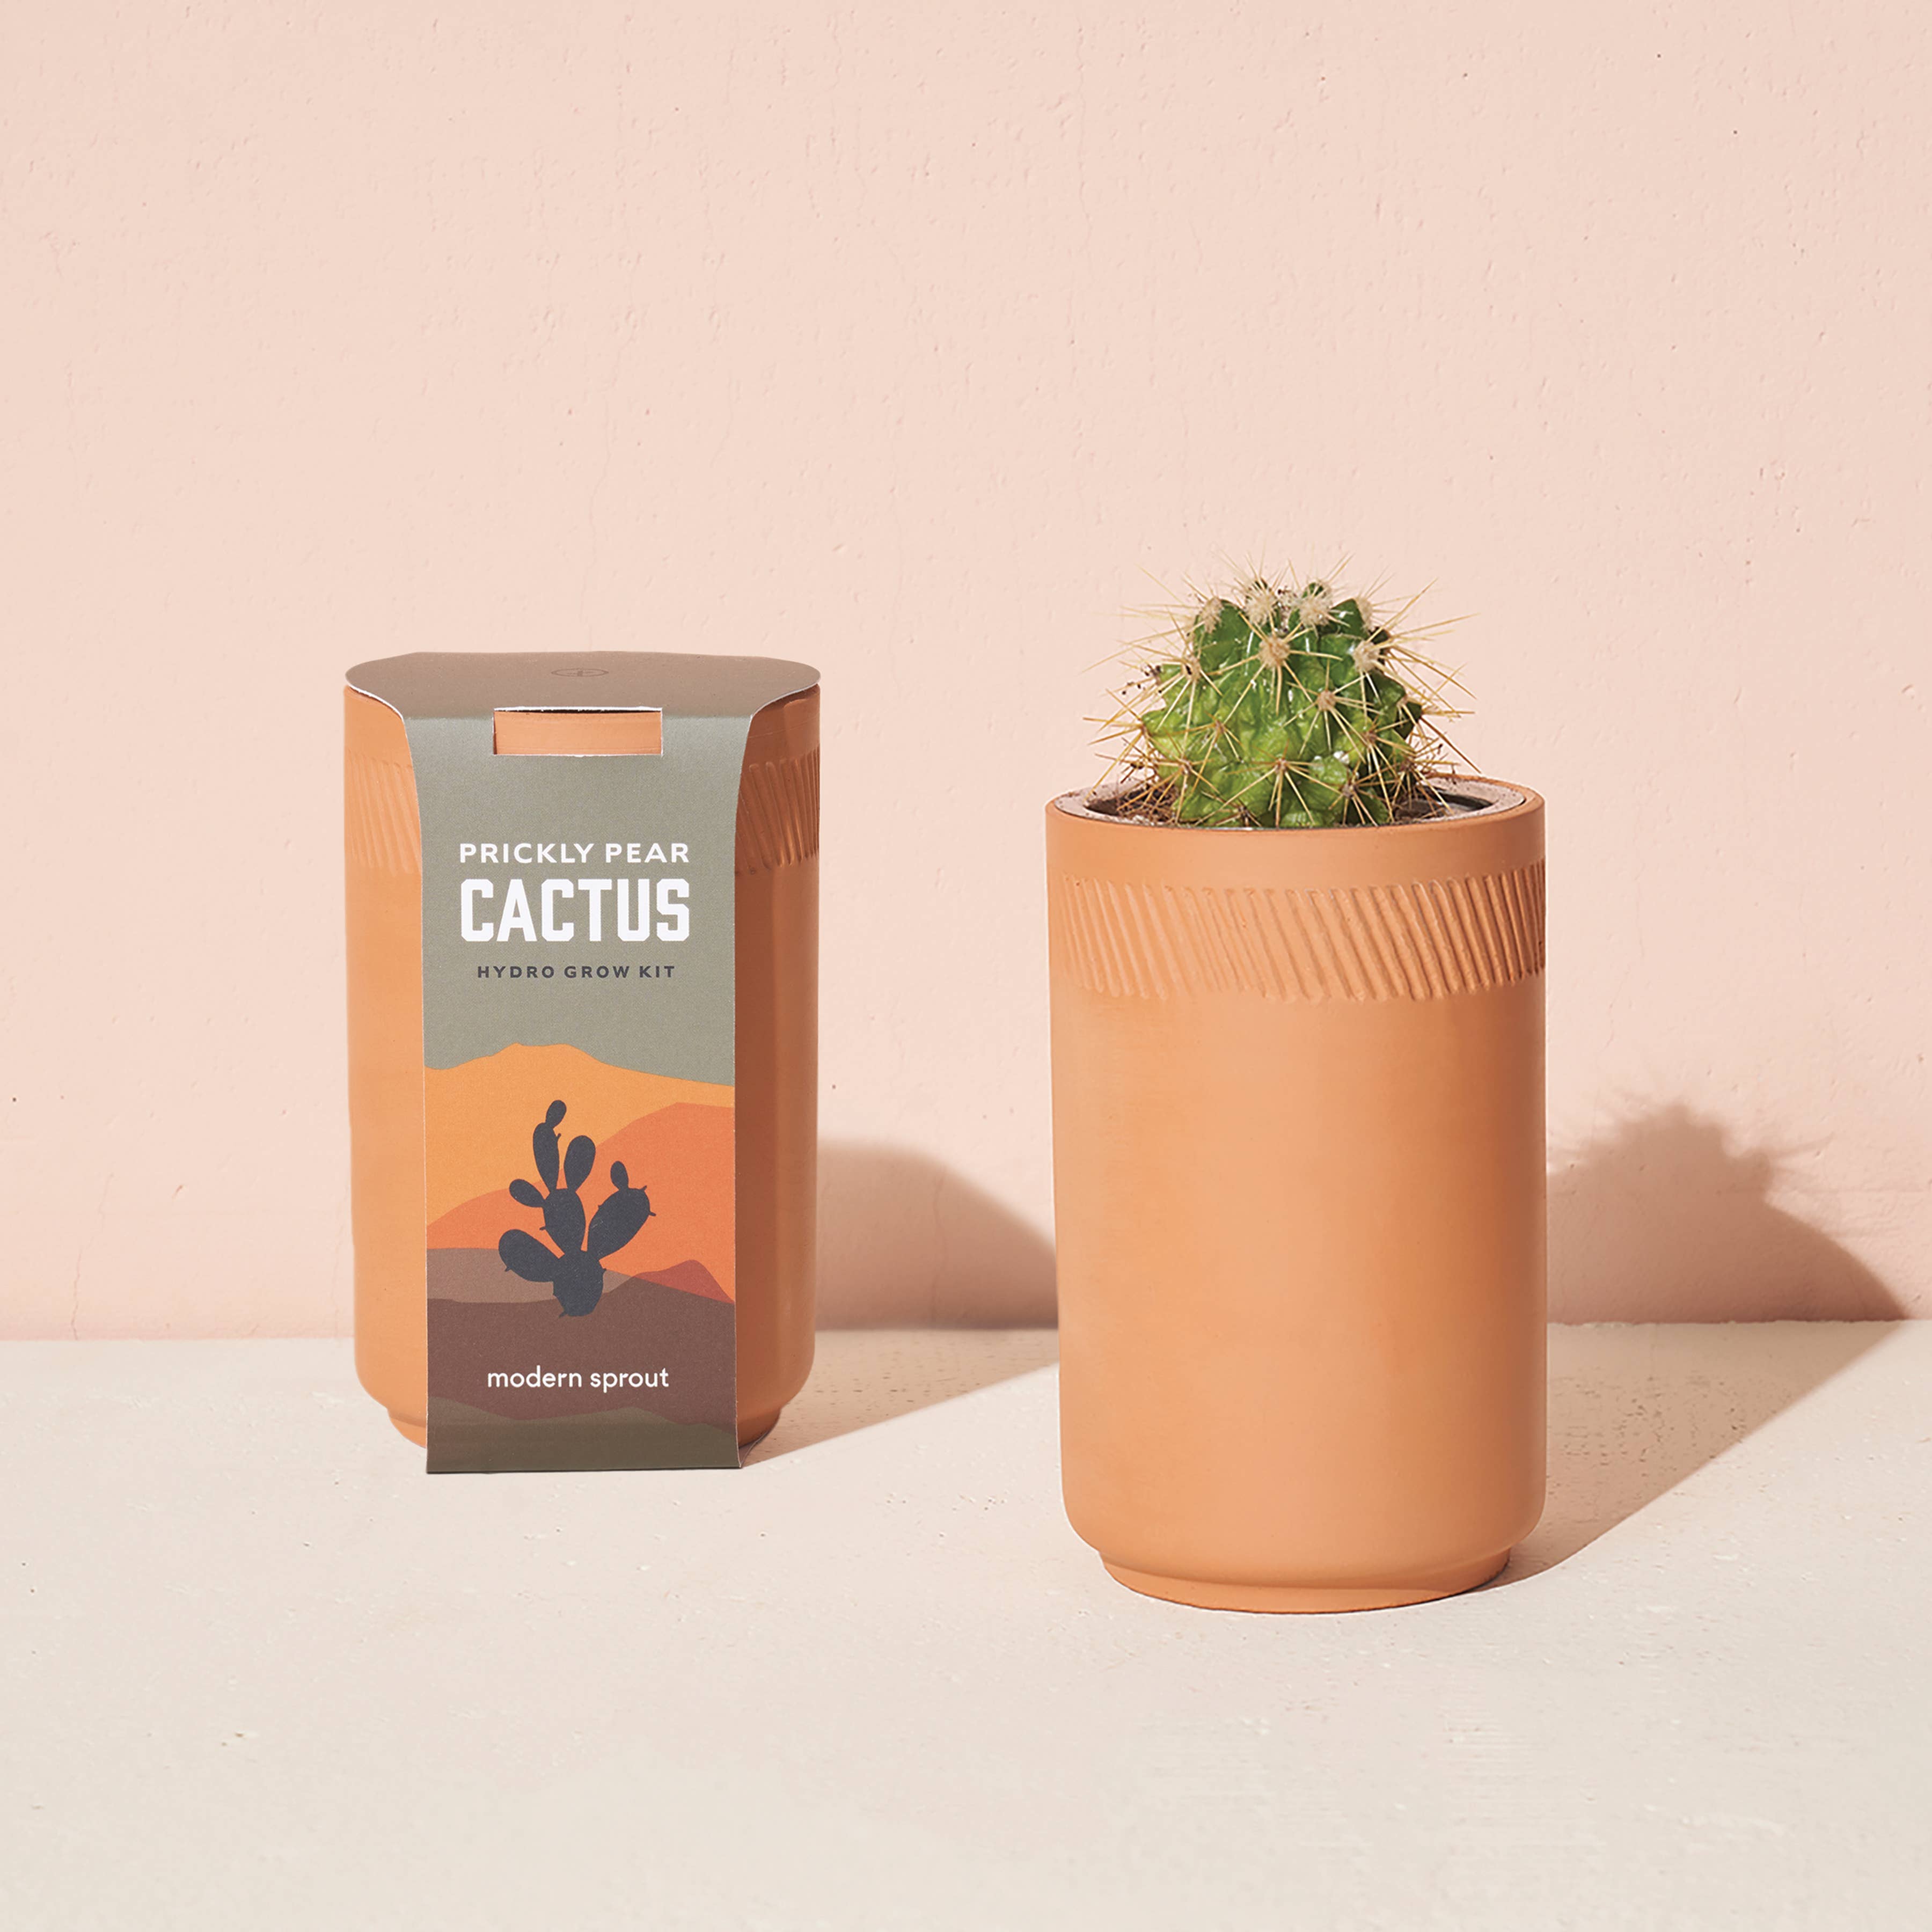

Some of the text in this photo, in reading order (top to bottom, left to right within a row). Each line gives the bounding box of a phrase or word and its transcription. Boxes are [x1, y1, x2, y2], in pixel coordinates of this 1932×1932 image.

[460, 843, 690, 863] PRICKLY PEAR
[460, 879, 690, 941] CACTUS
[477, 965, 676, 978] HYDRO GROW KIT
[487, 1365, 669, 1393] modern sprout
